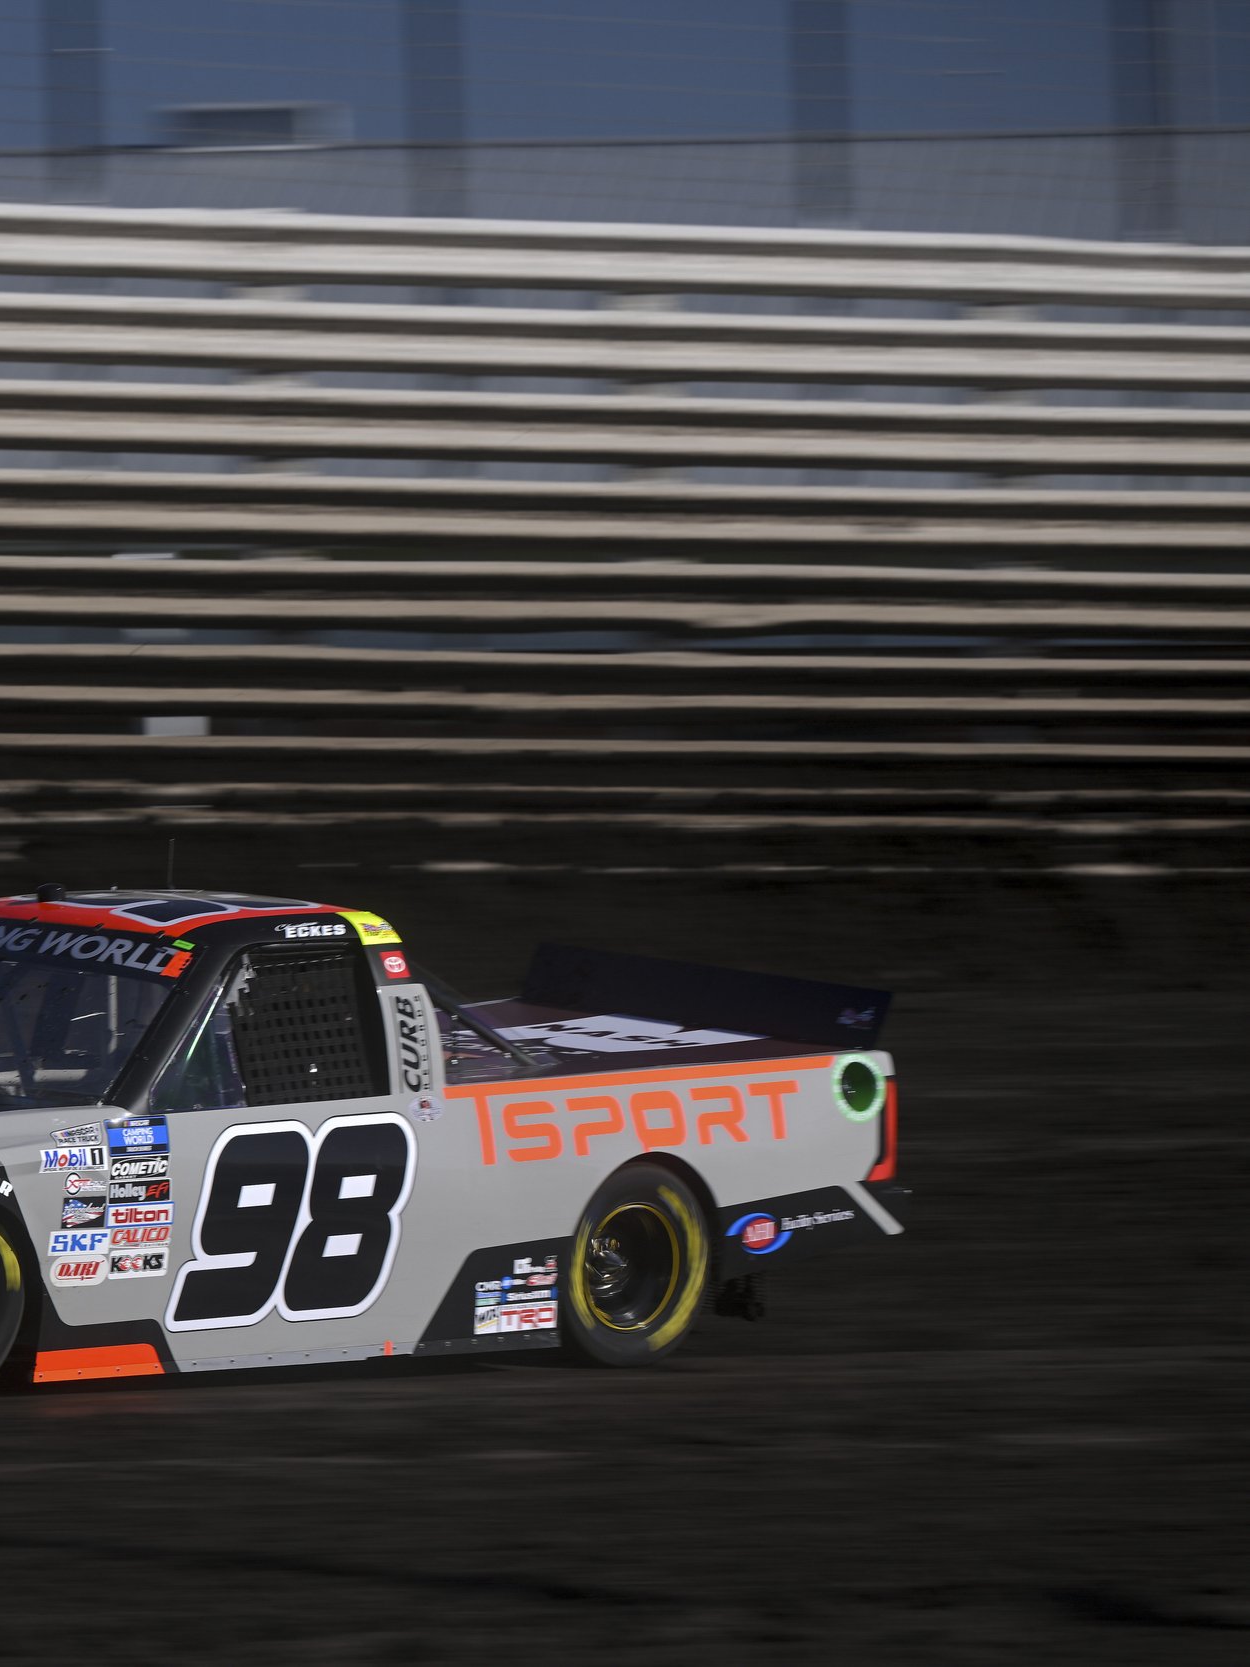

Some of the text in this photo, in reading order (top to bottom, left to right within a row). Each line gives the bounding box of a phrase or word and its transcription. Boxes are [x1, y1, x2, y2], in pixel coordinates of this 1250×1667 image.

[284, 924, 347, 938] ECKES
[397, 996, 421, 1093] CURB
[77, 1134, 98, 1143] TRUCK
[122, 1127, 154, 1137] CAMPING
[123, 1135, 155, 1146] WORLD
[43, 1148, 87, 1168] Mobil
[92, 1149, 102, 1165] 1
[111, 1158, 168, 1176] COMETIC
[109, 1183, 147, 1201] Holley
[112, 1208, 169, 1224] tilton
[164, 1111, 418, 1333] 98
[51, 1233, 108, 1253] SKF
[111, 1227, 170, 1245] CALICO
